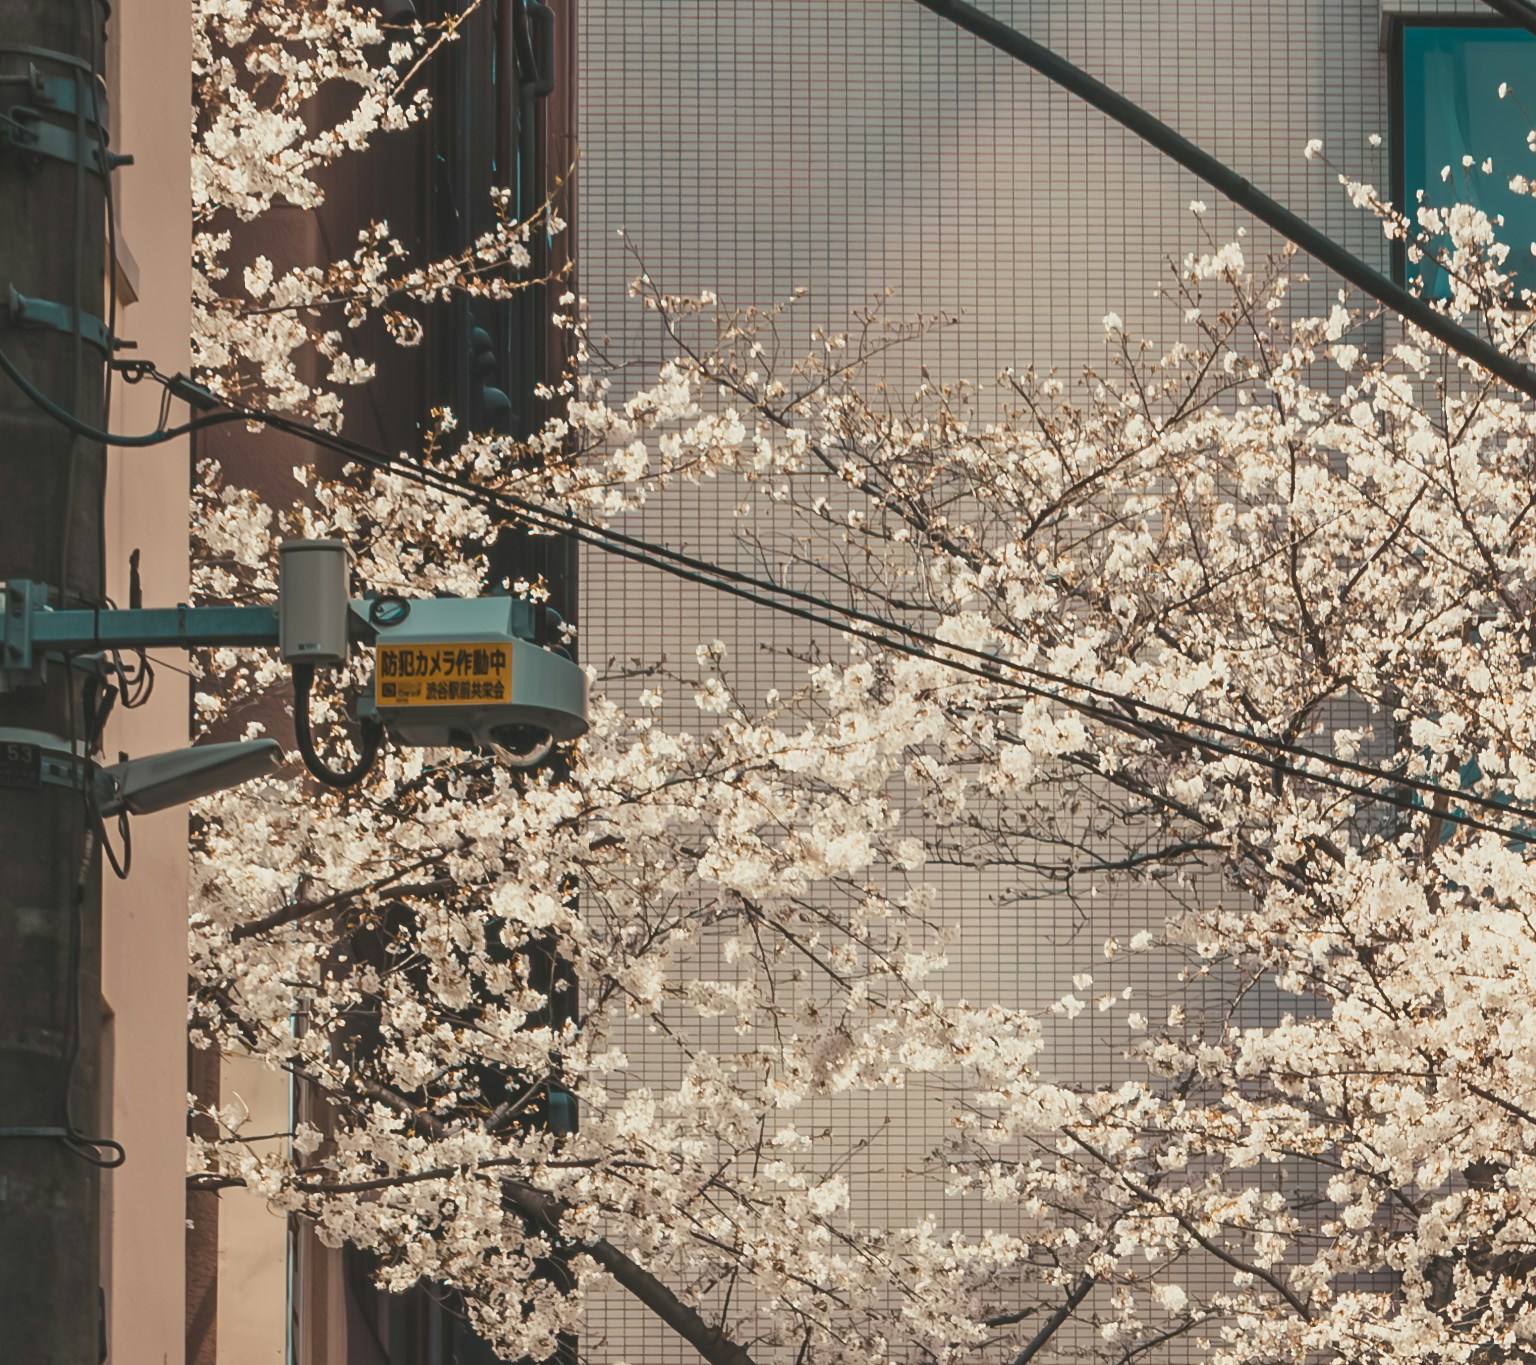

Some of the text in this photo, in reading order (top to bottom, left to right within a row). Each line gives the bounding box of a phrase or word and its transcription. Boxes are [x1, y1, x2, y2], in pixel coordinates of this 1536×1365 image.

[381, 648, 506, 677] 防犯カメラ作動中
